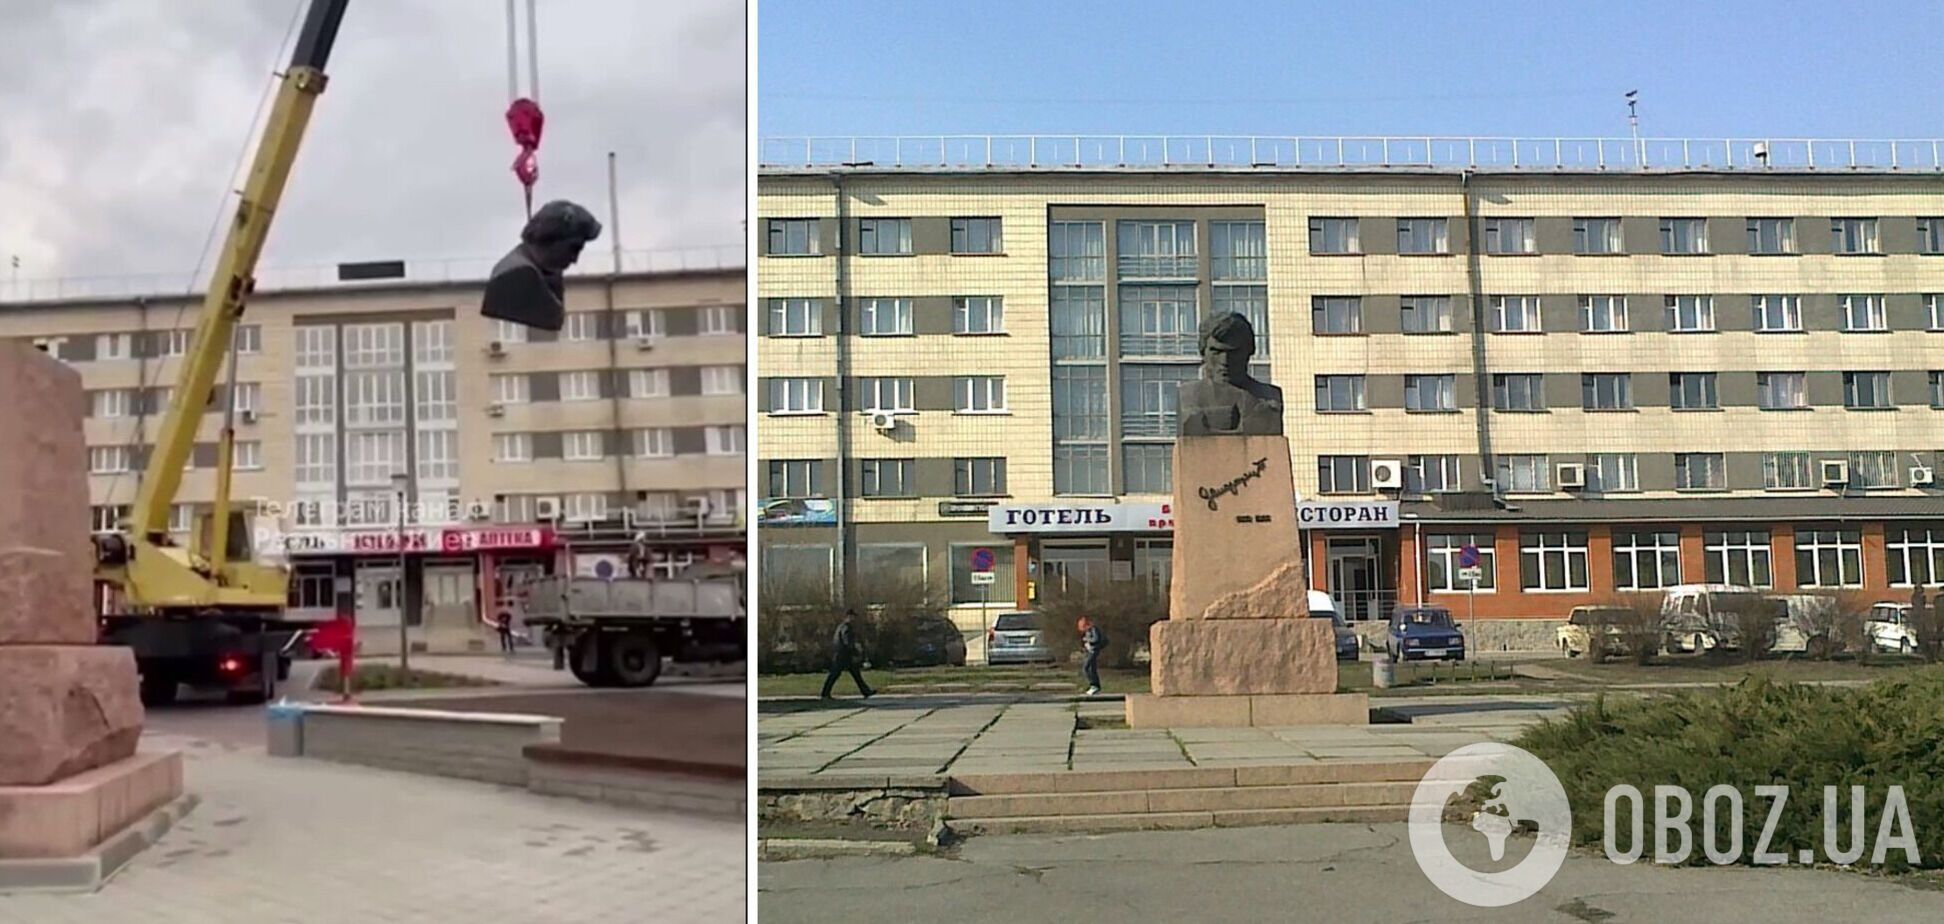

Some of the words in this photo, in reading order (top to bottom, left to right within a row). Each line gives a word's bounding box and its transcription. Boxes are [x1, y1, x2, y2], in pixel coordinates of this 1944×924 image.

[1006, 508, 1112, 525] ГОТЕЛЬ
[1295, 506, 1388, 522] СТОРАН
[480, 530, 533, 546] АПТЕКА
